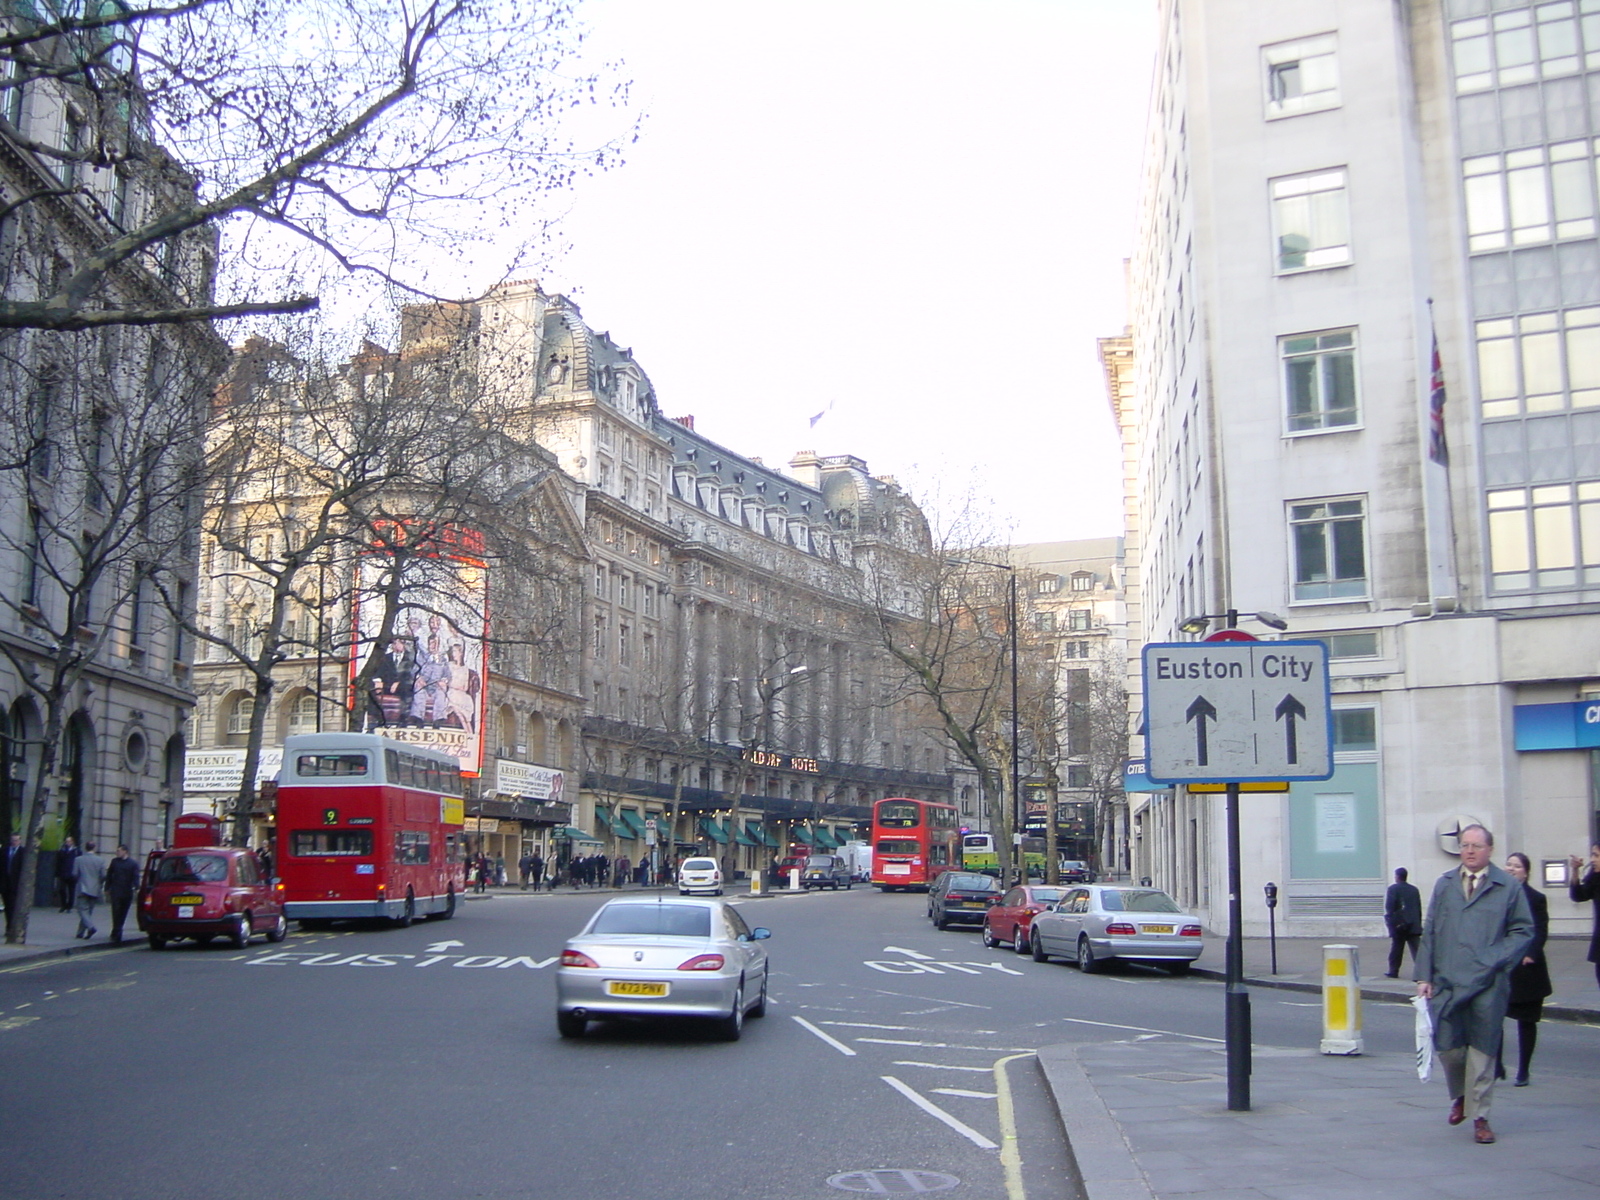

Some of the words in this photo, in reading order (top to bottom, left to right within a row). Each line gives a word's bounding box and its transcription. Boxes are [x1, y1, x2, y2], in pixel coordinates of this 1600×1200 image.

[1156, 657, 1243, 680] Euston
[1262, 655, 1313, 682] City
[381, 730, 465, 745] ARSENIC
[188, 756, 234, 765] RSENIC
[791, 758, 819, 772] HOTEL
[501, 765, 528, 777] ARSENIC
[1127, 763, 1146, 775] CITIB
[327, 810, 335, 821] 9
[244, 953, 561, 969] EUSTON
[863, 961, 1025, 976] CITY
